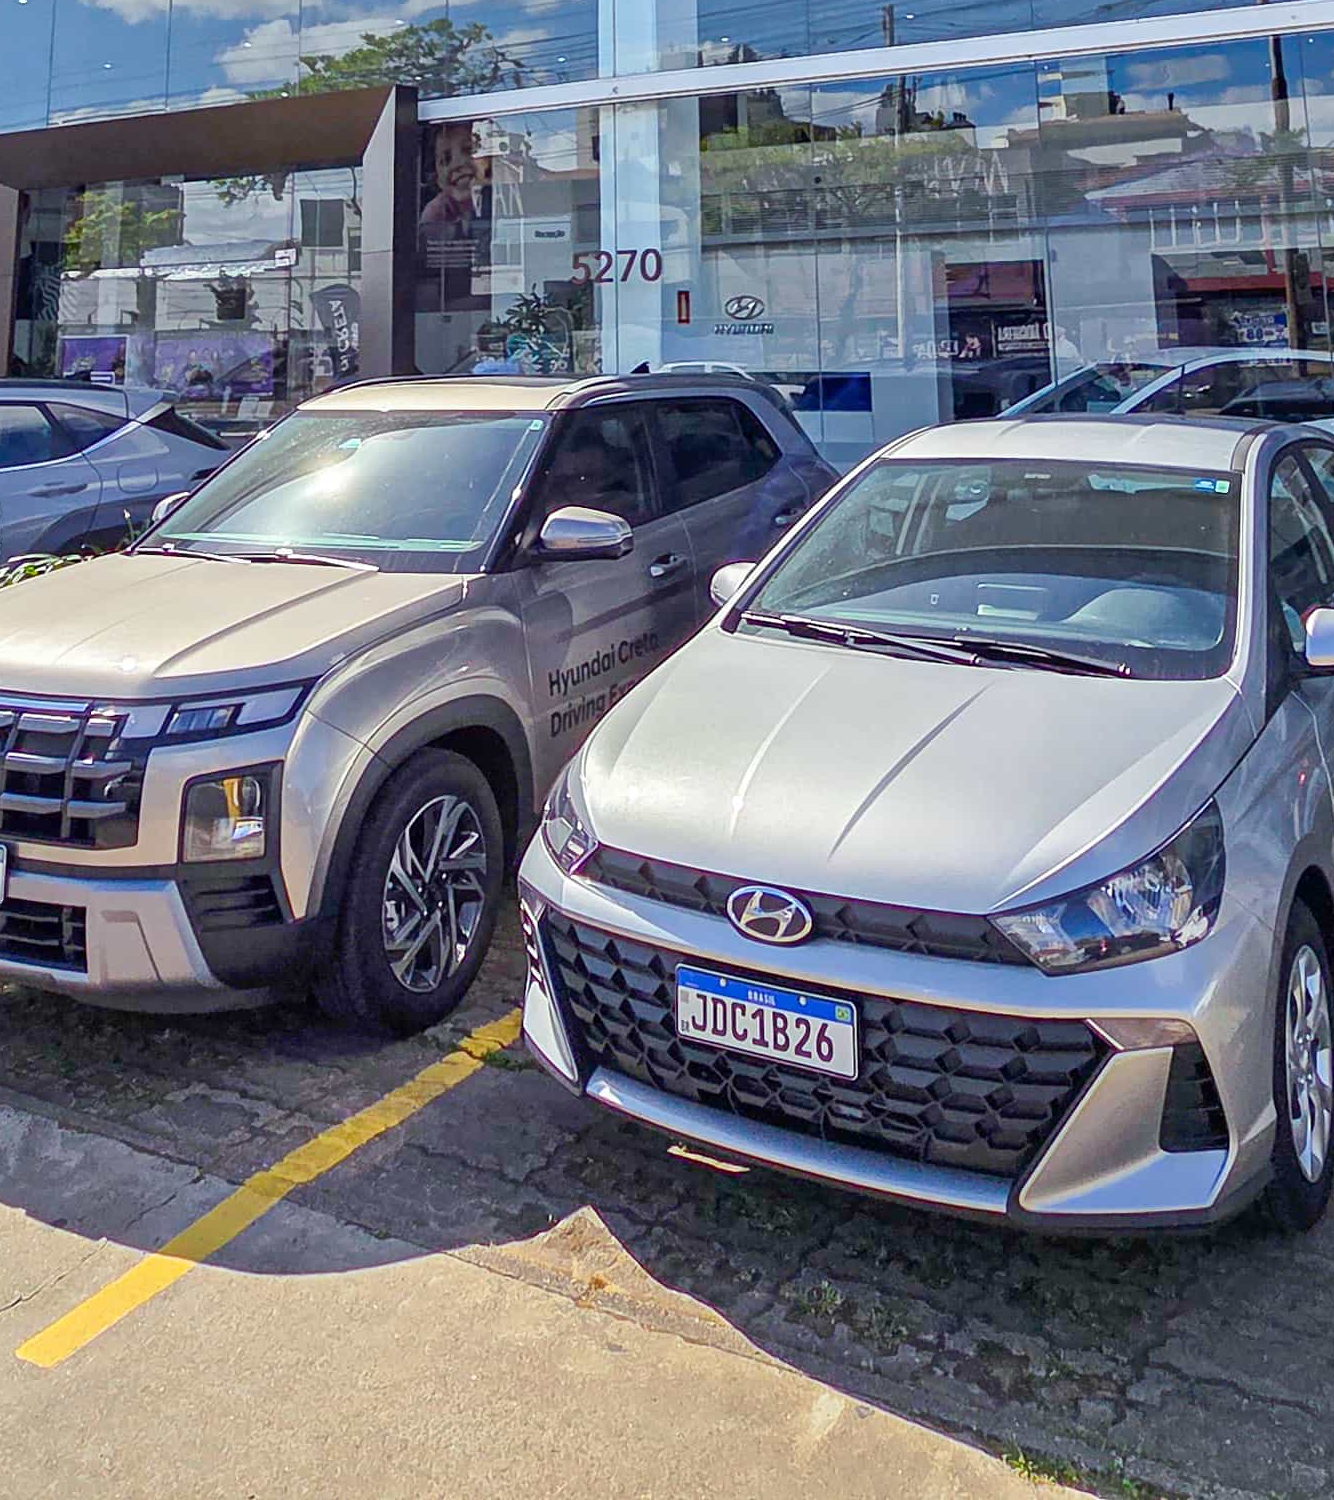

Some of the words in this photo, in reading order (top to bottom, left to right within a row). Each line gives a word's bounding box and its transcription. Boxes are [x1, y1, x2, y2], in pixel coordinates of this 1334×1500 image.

[570, 248, 663, 286] 5270
[714, 323, 774, 336] HYUNDAI
[548, 643, 617, 698] Hyundai
[618, 632, 660, 665] Creta
[550, 690, 606, 738] Driving
[690, 992, 835, 1064] JDC1B26
